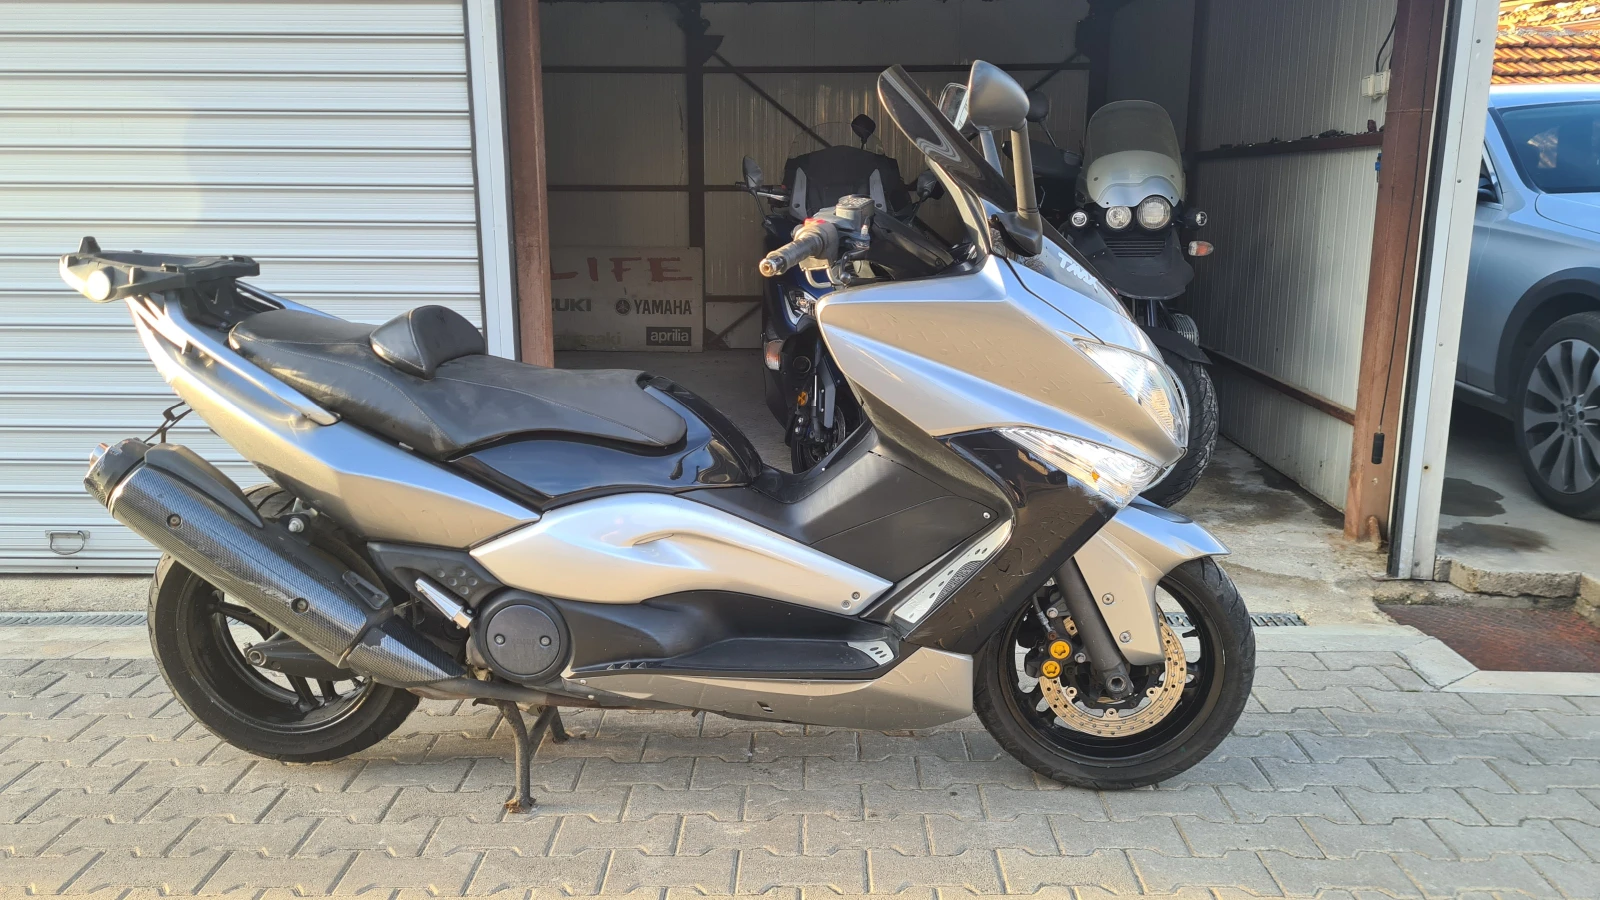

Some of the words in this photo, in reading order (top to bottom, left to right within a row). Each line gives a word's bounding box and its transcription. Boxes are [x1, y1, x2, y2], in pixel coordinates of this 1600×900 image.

[550, 257, 693, 282] LIFE
[633, 299, 692, 315] YAMAHA
[650, 328, 689, 343] aprilia
